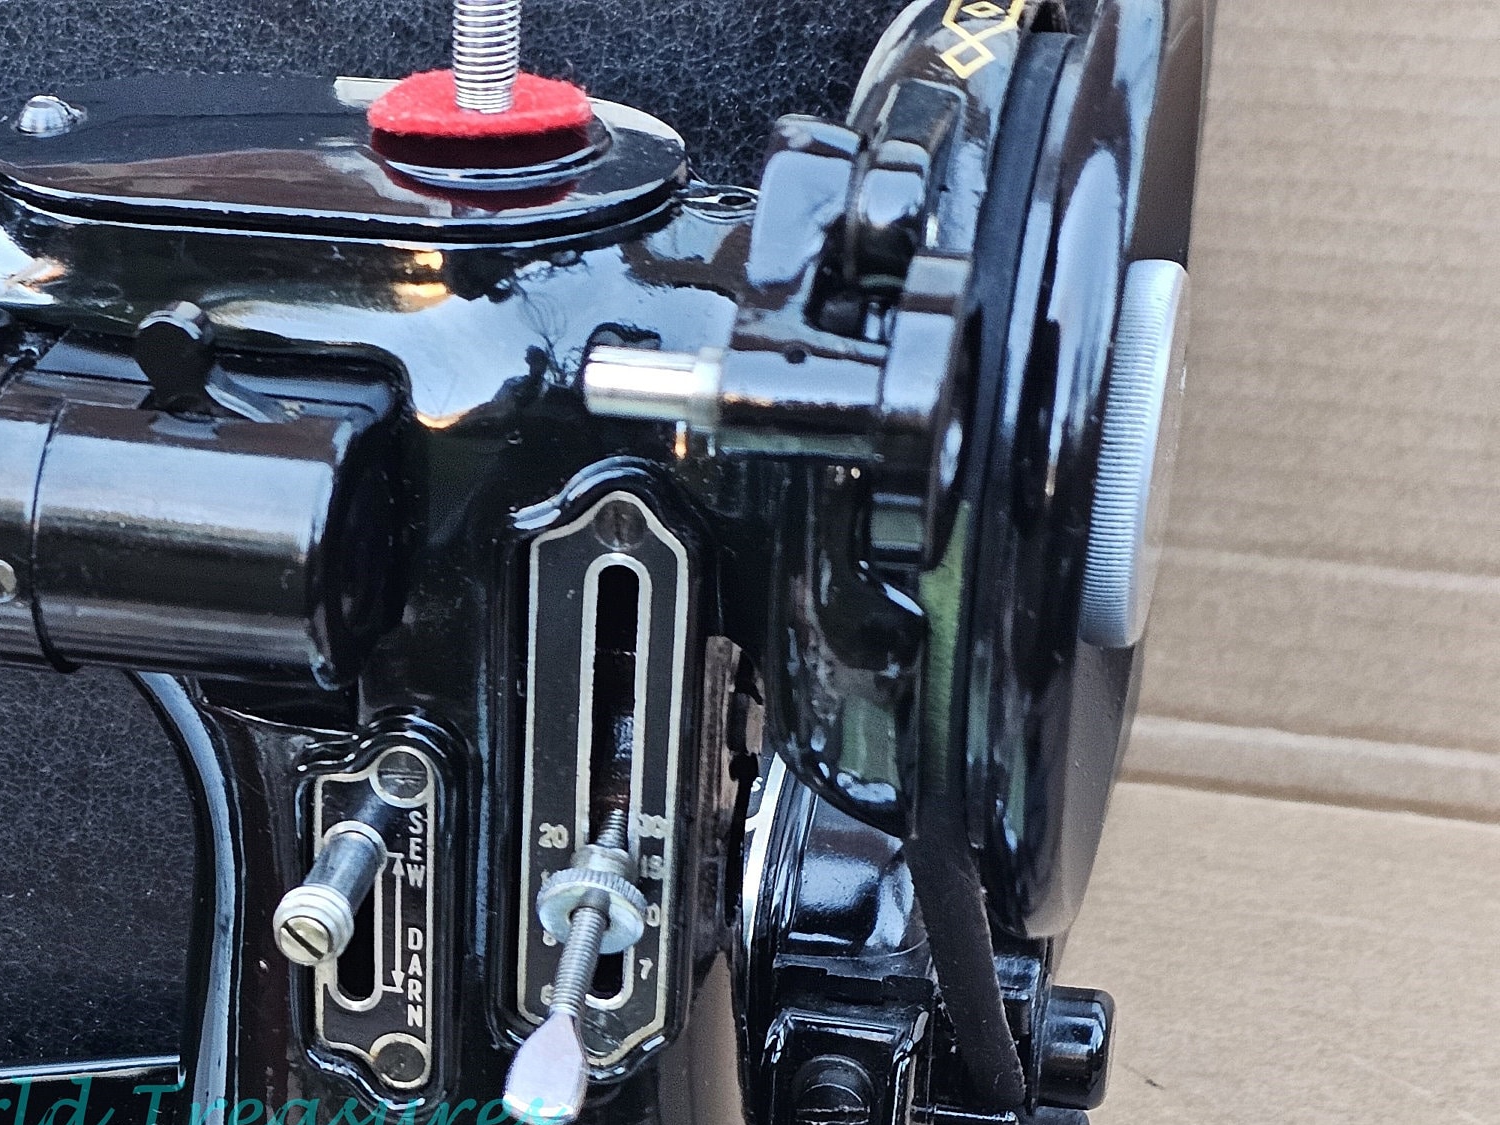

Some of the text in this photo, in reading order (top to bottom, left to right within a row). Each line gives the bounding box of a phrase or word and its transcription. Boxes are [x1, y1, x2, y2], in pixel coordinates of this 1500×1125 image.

[406, 811, 427, 889] SEW
[538, 822, 569, 849] 20
[406, 926, 426, 1028] DARN
[638, 957, 654, 981] 7
